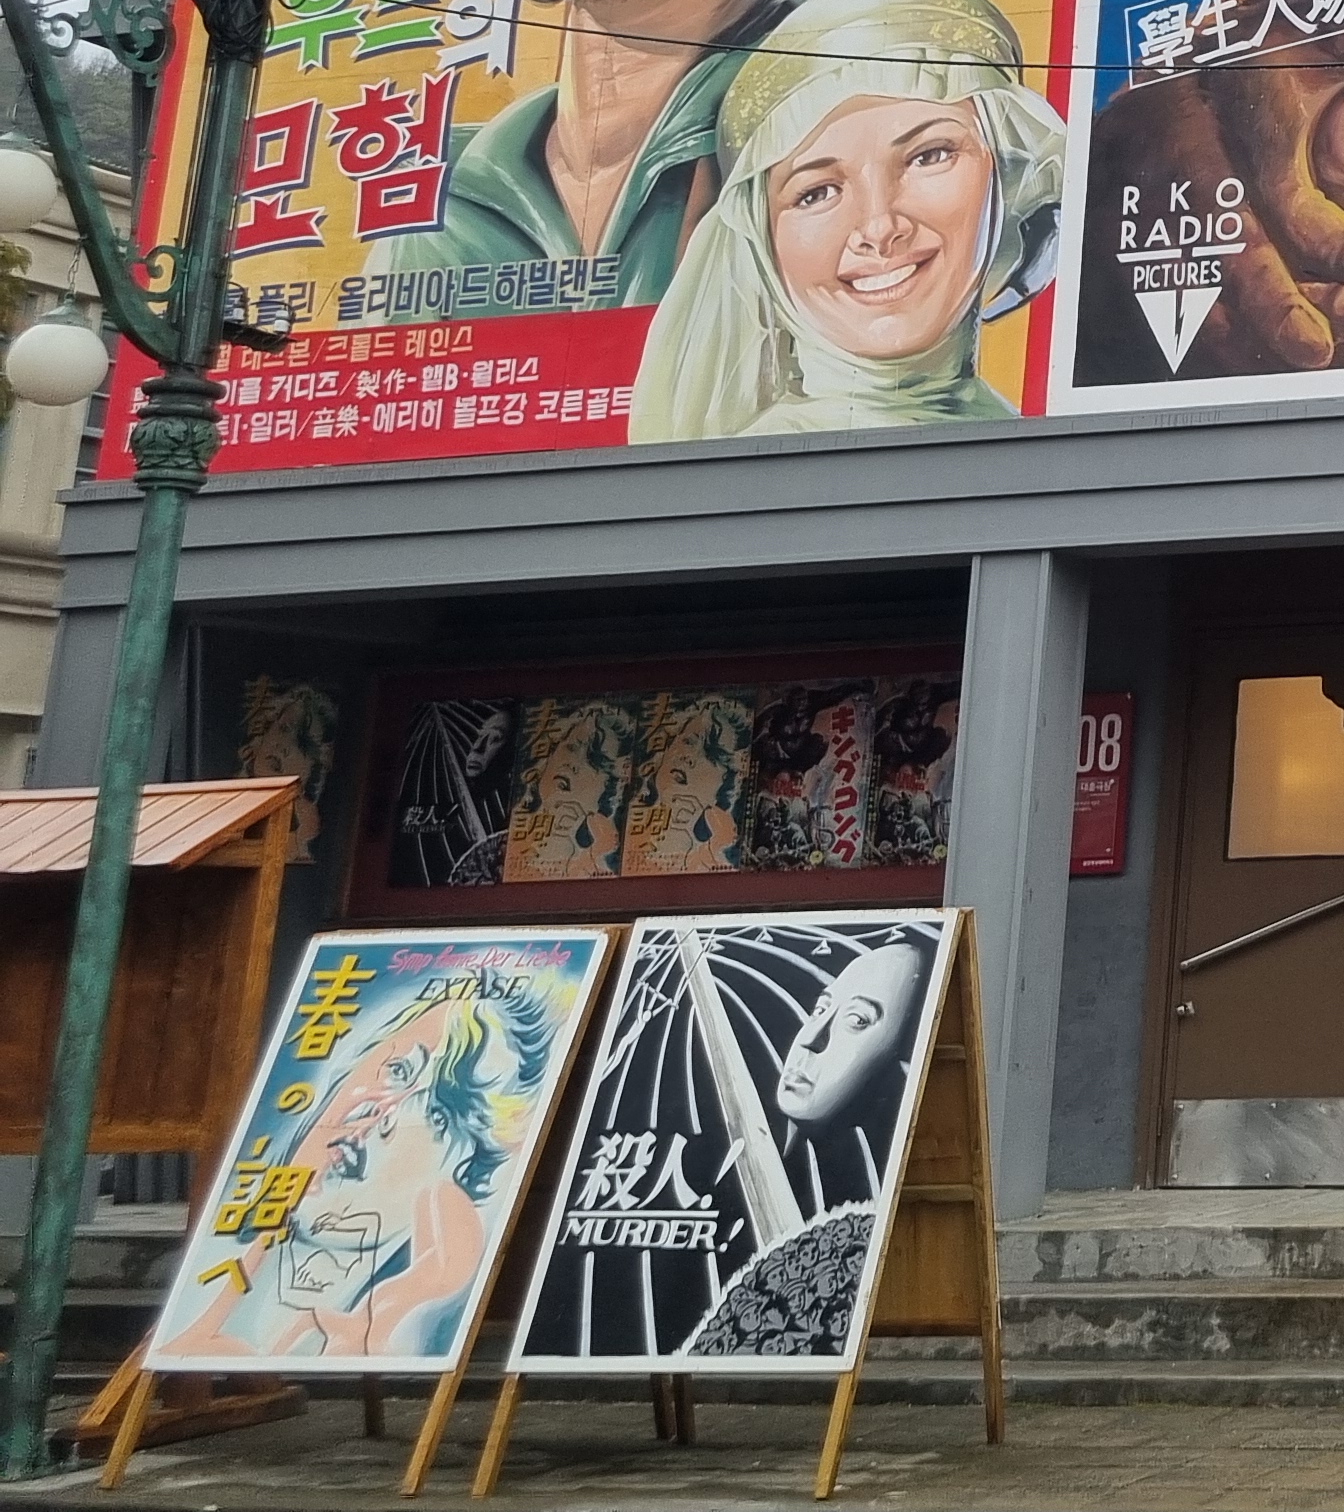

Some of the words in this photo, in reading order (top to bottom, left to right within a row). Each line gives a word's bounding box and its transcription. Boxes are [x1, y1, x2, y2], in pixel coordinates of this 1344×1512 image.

[232, 68, 459, 253] 모험
[1120, 211, 1243, 249] RADIO
[1133, 261, 1222, 289] PICTURES
[404, 326, 473, 359] 레인스
[453, 392, 528, 429] 볼프강
